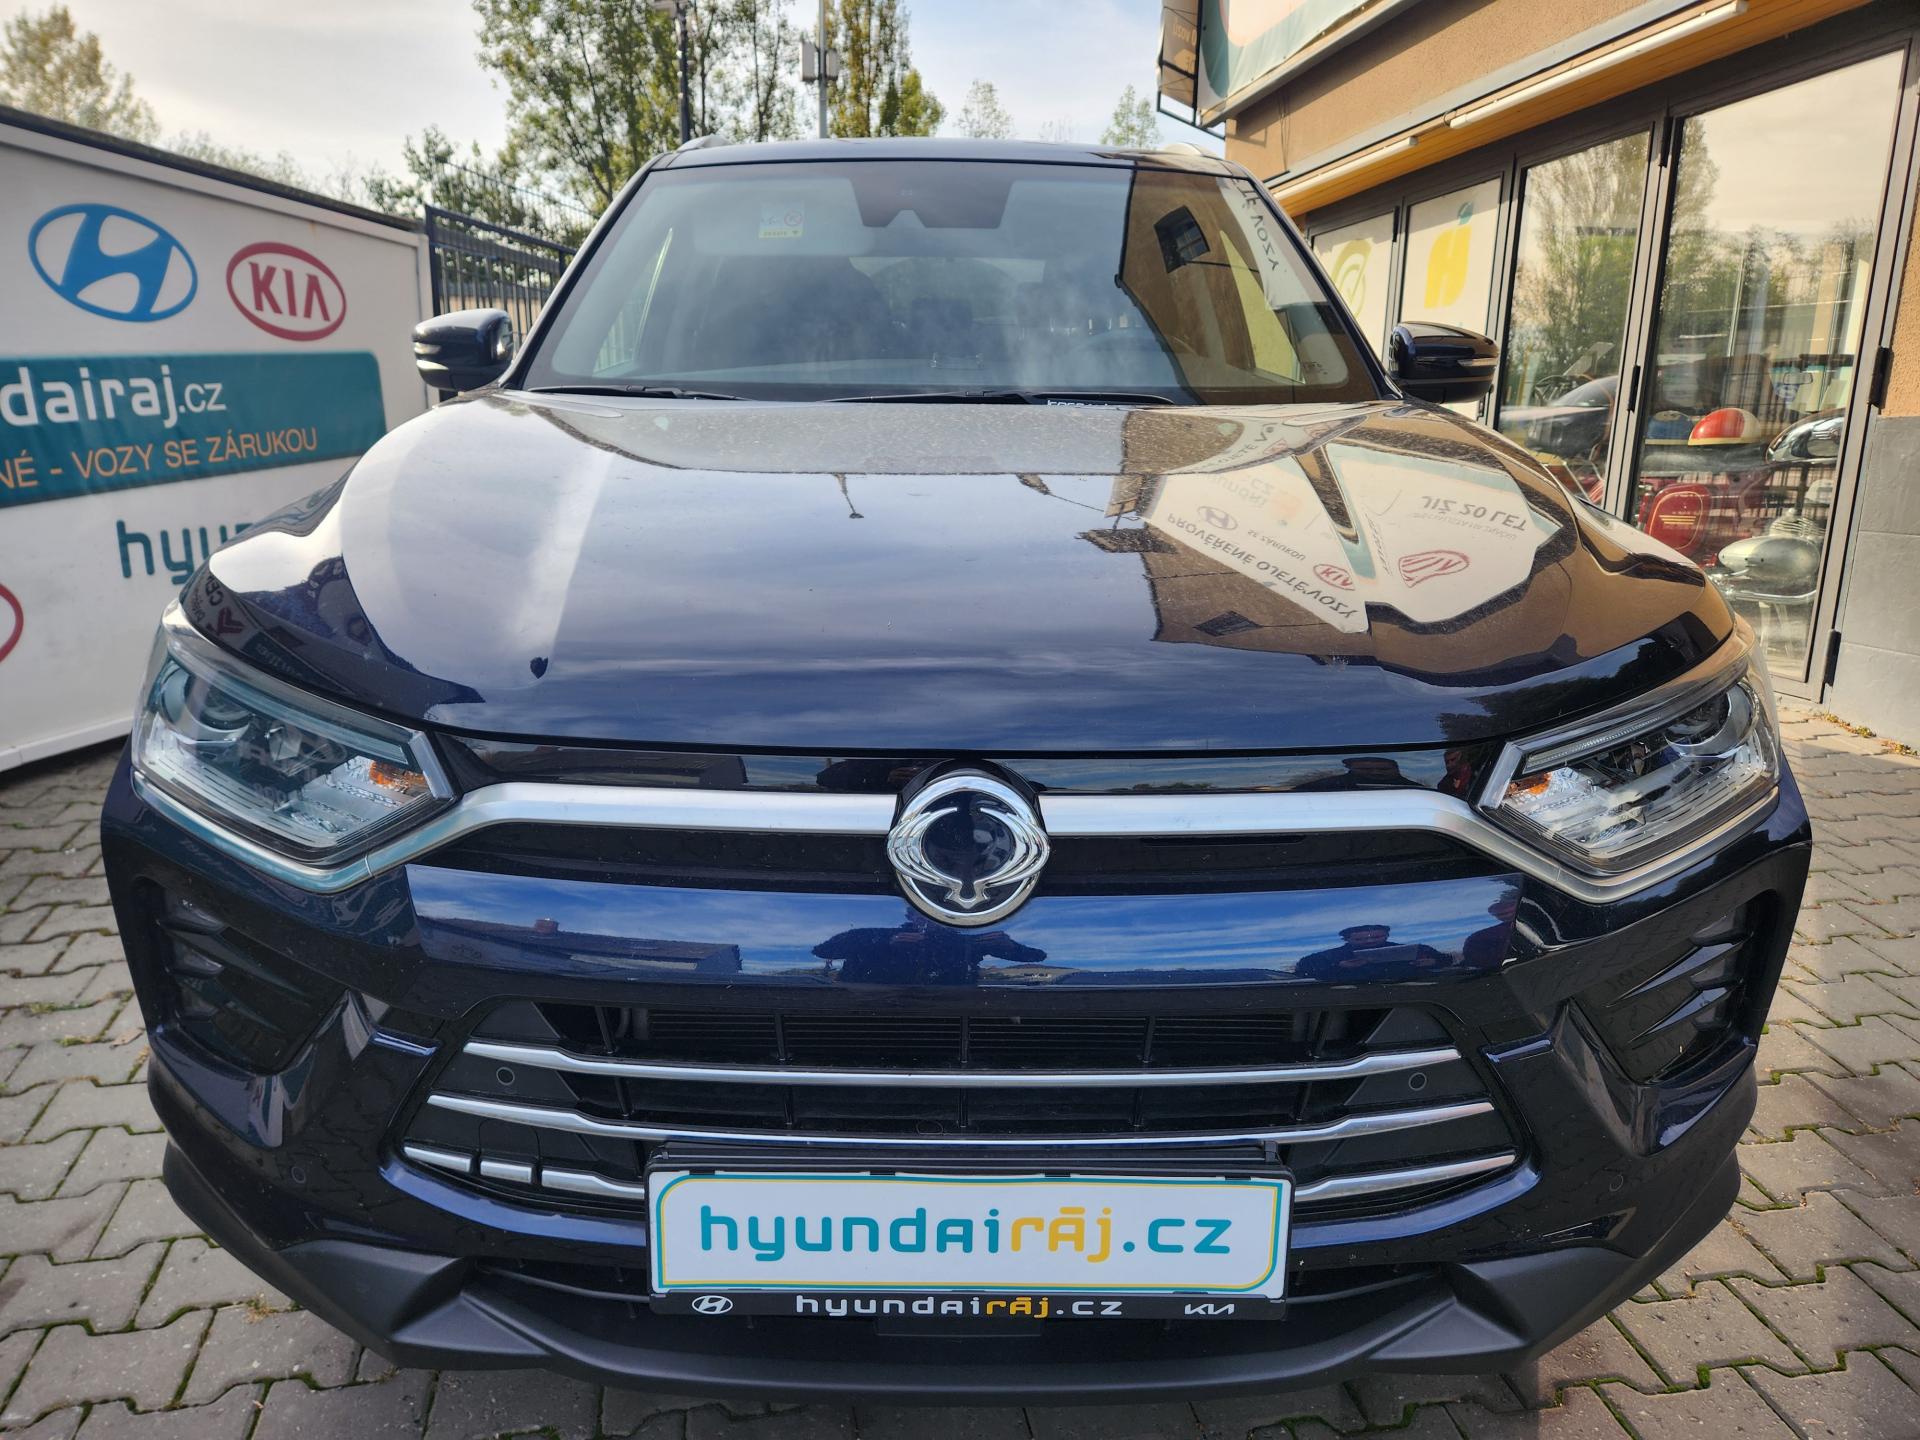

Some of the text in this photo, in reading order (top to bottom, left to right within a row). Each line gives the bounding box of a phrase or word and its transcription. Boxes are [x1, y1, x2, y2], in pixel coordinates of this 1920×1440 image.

[247, 261, 332, 323] KIA
[71, 443, 154, 480] VOZY
[164, 438, 199, 469] SE
[205, 426, 319, 464] ZÁRUKOU
